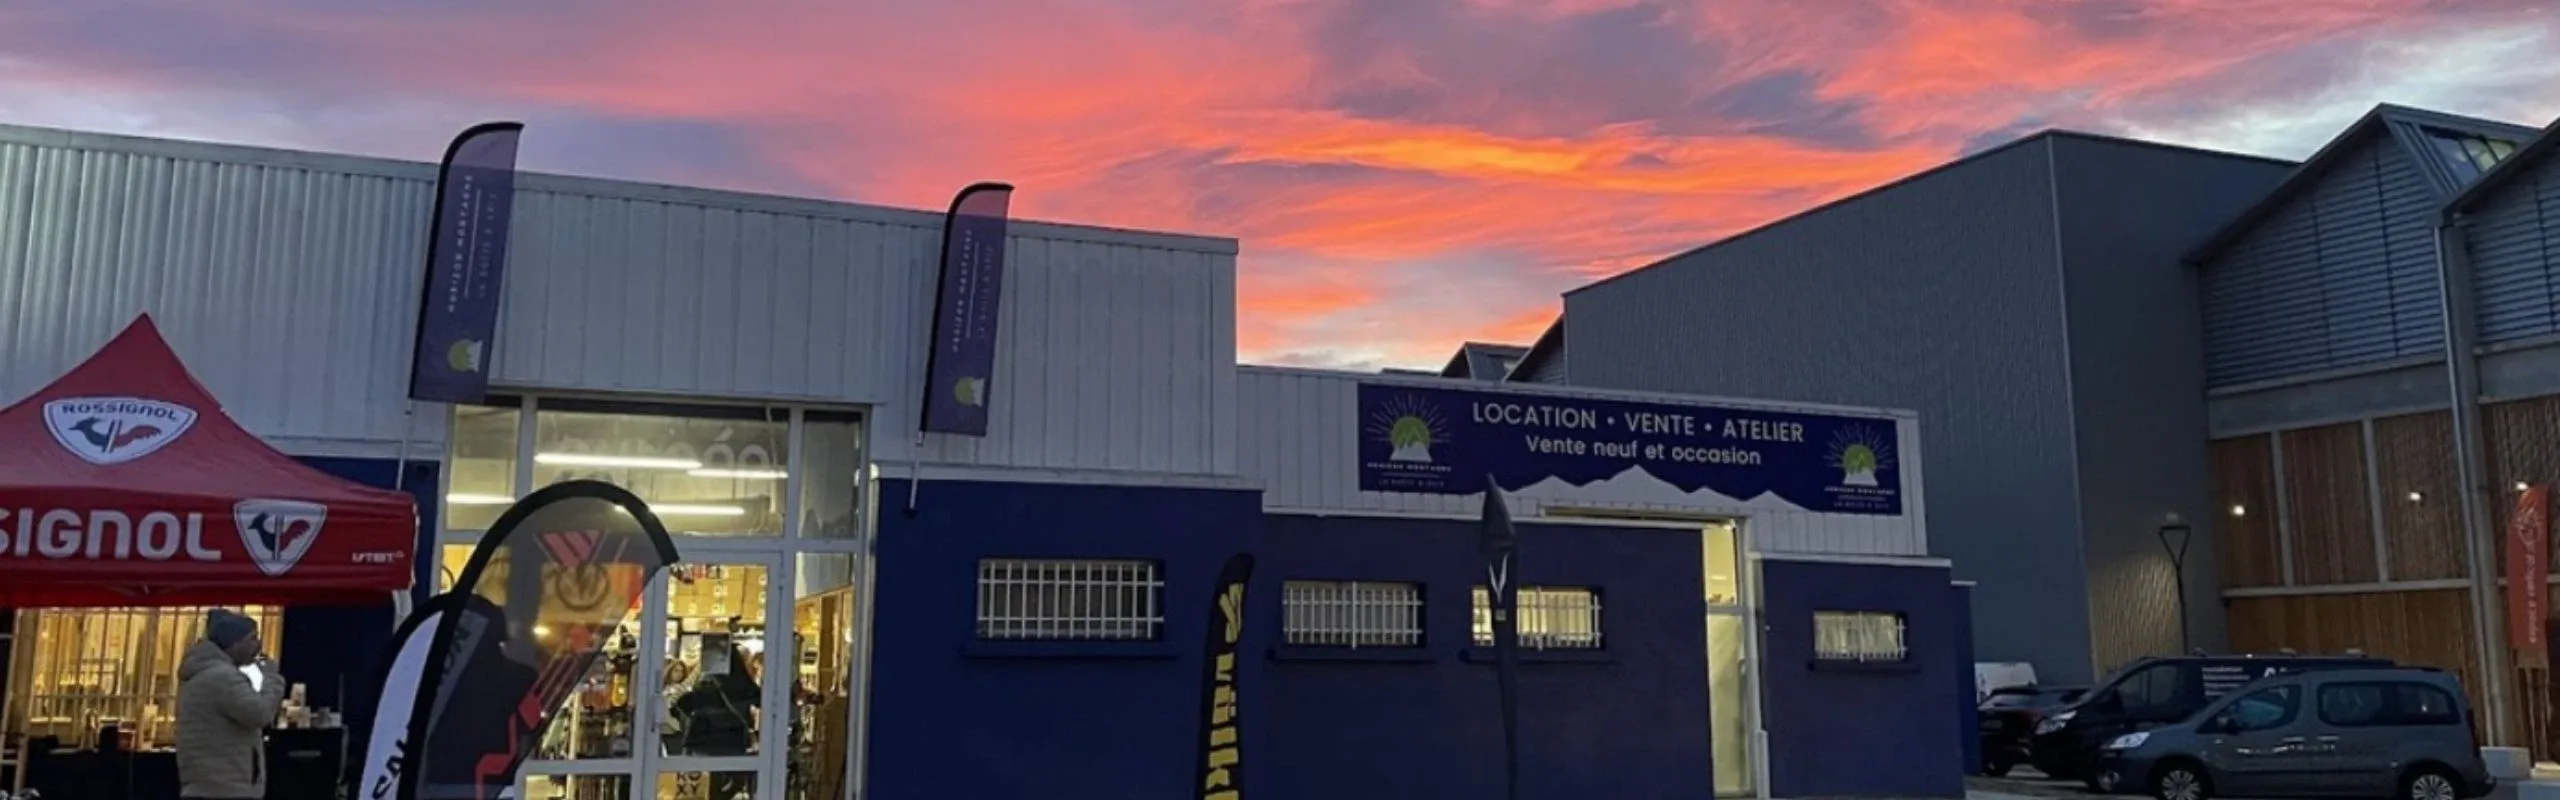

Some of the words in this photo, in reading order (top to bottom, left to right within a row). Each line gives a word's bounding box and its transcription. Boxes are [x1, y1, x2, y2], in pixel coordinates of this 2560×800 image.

[61, 402, 177, 421] ROSSIGNOL
[1472, 401, 1596, 430] LOCATION
[1624, 411, 1696, 436] VENTE
[1722, 417, 1804, 443] ATELIER
[1525, 434, 1586, 455] Vente
[1593, 439, 1639, 458] neuf
[1645, 443, 1666, 461] et
[1671, 446, 1762, 465] occasion
[0, 507, 223, 561] IGNOL
